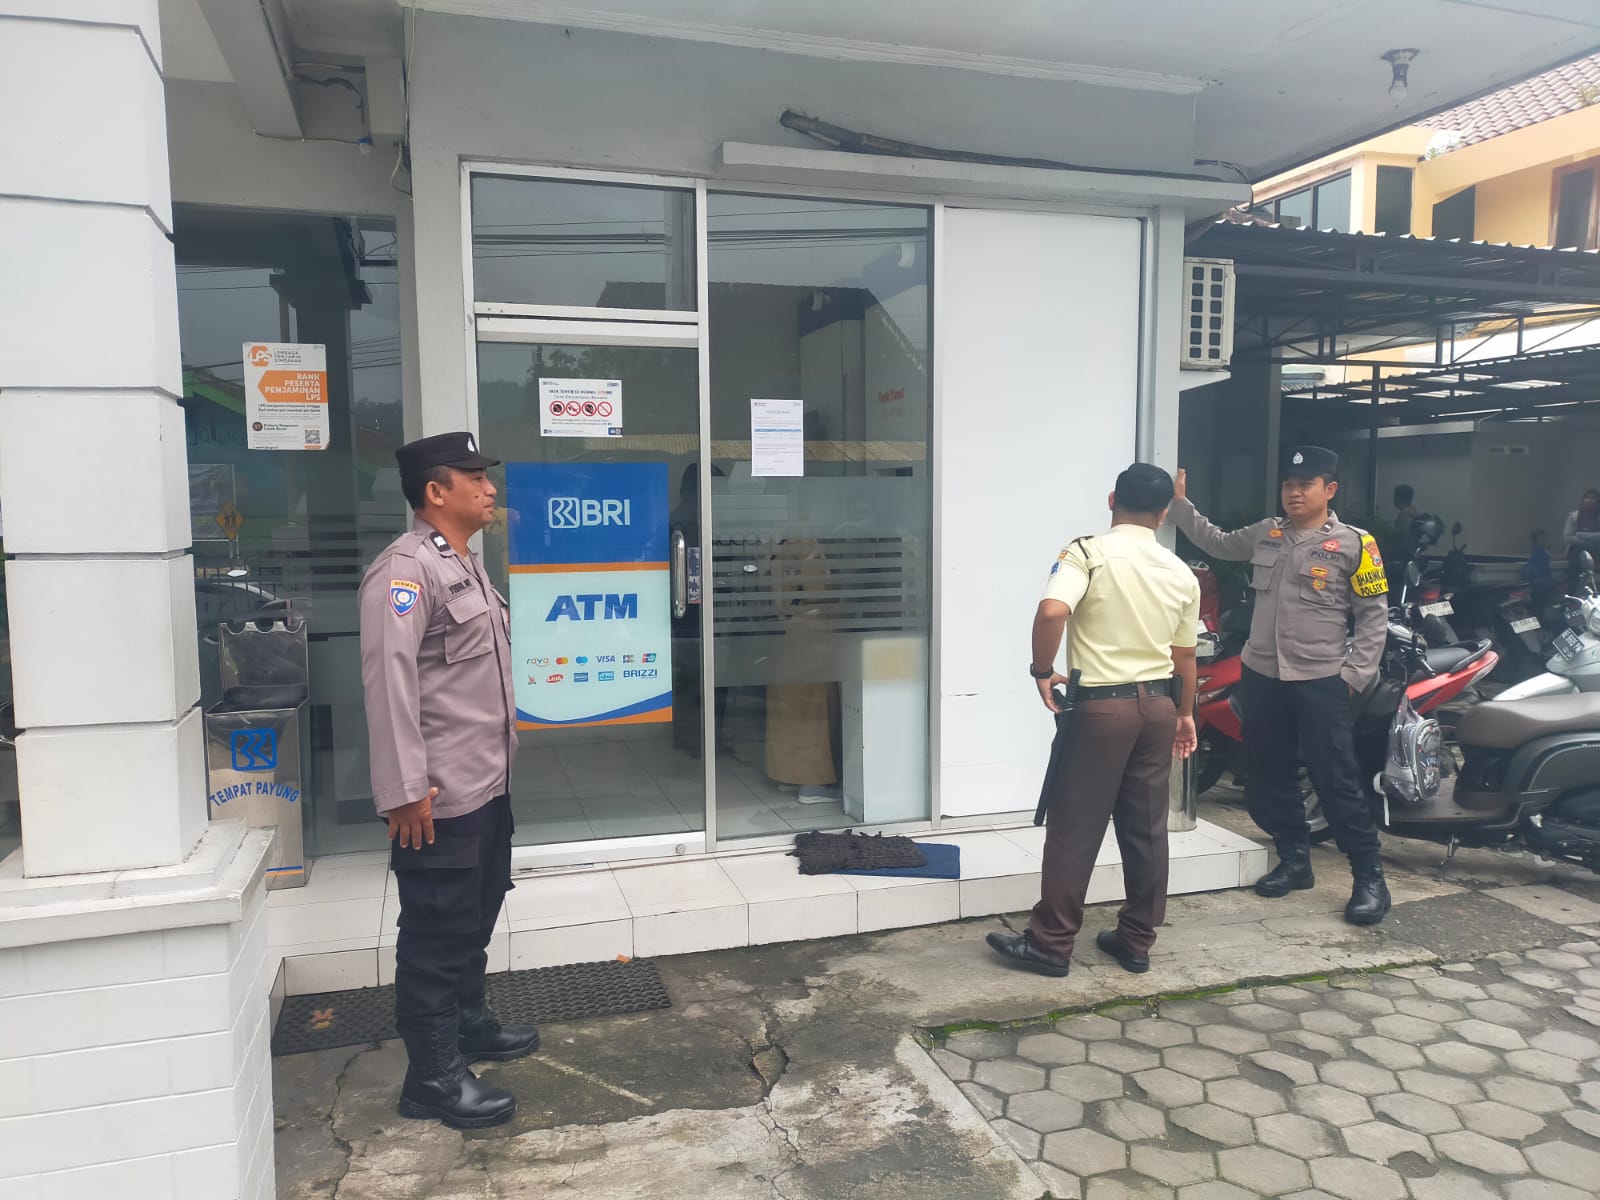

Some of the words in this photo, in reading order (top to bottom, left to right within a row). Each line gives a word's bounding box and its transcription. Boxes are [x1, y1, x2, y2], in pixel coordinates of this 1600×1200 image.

[582, 499, 630, 526] BRI
[1310, 551, 1340, 563] POLRI
[1360, 584, 1382, 596] POLSEK
[545, 593, 638, 622] ATM
[596, 655, 616, 663] VISA
[624, 669, 657, 678] BRIZZI
[210, 782, 252, 807] TEMPAT
[256, 781, 300, 803] PAYUNG
